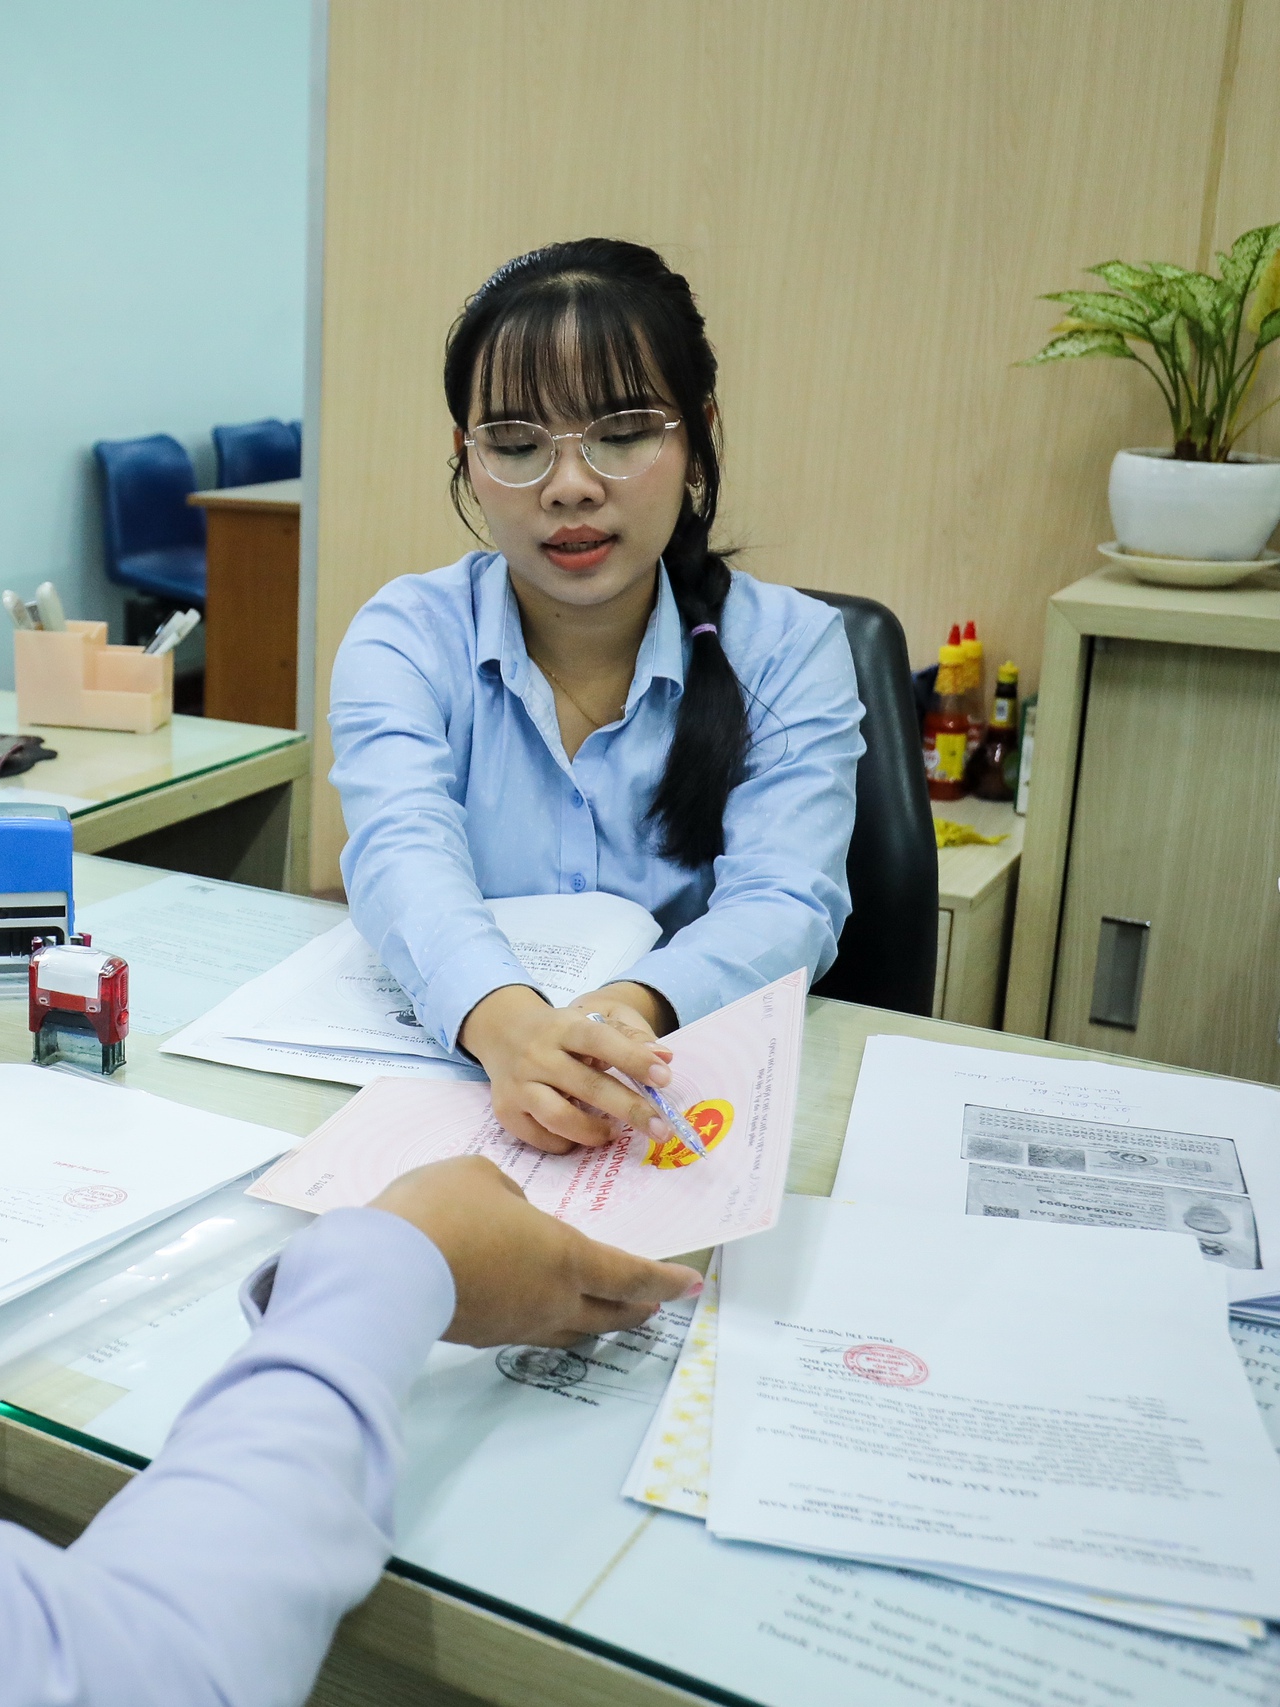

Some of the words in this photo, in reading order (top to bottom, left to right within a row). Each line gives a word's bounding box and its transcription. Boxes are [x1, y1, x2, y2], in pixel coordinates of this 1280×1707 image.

[605, 1136, 631, 1177] CHỨNG
[753, 1154, 762, 1170] NAM
[590, 1180, 614, 1212] NHẬN
[1058, 1213, 1094, 1224] CÔNG
